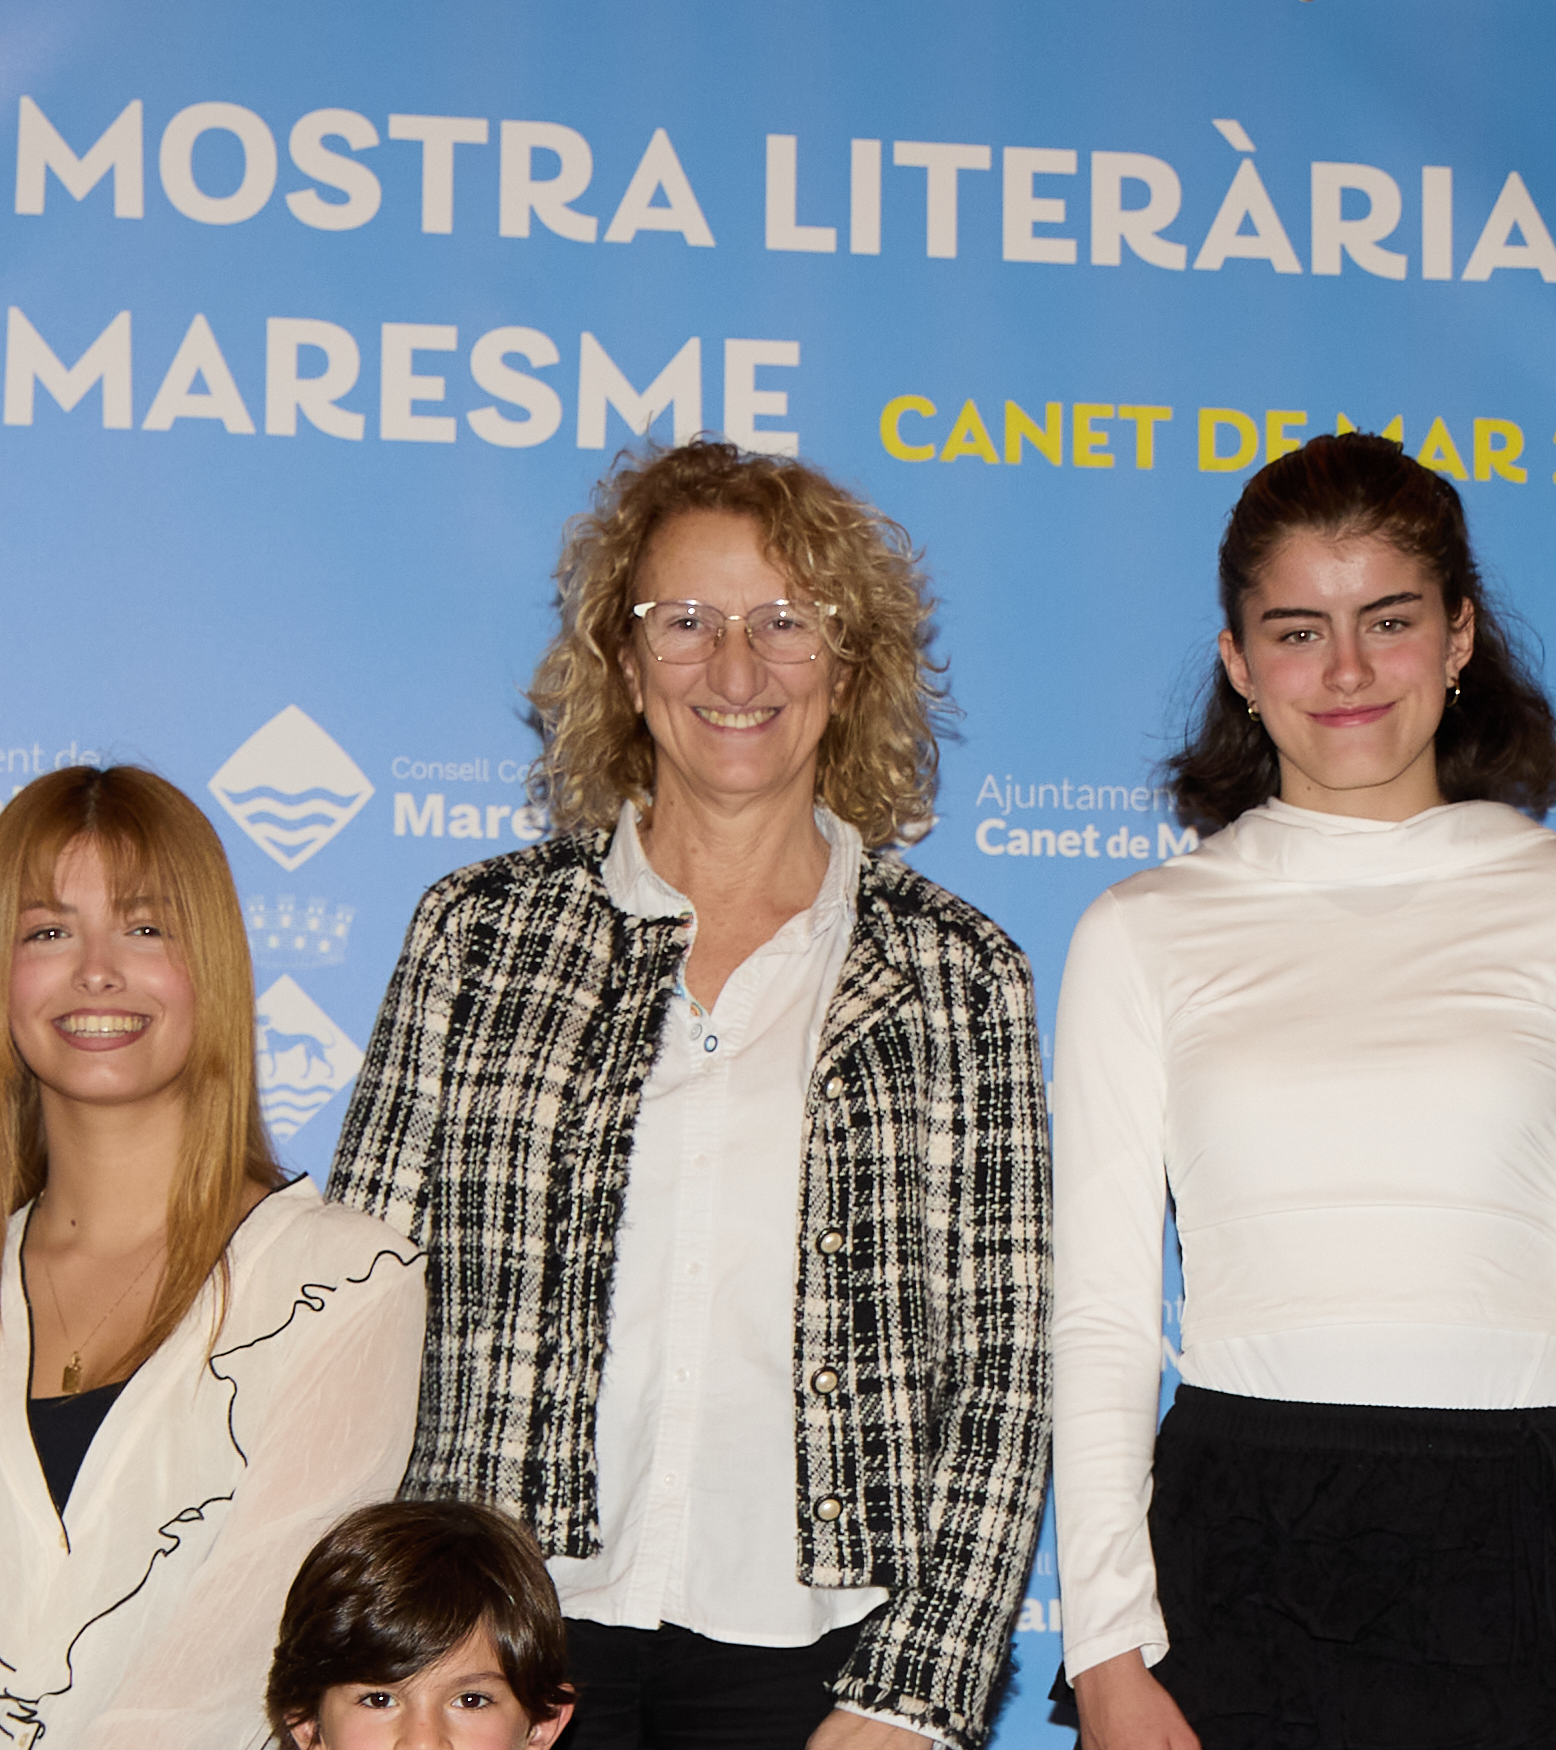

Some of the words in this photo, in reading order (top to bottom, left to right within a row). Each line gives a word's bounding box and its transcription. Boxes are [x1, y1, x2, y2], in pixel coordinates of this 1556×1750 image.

[14, 96, 717, 248] MOSTRA
[2, 305, 802, 458] MARESME
[879, 394, 1173, 469] CANET
[1197, 406, 1308, 473] DE
[53, 740, 101, 771] de
[391, 756, 491, 783] Consell
[392, 793, 551, 841] Mare
[975, 773, 1177, 817] Ajuntamen
[975, 817, 1101, 858] Canet
[1106, 826, 1151, 860] de
